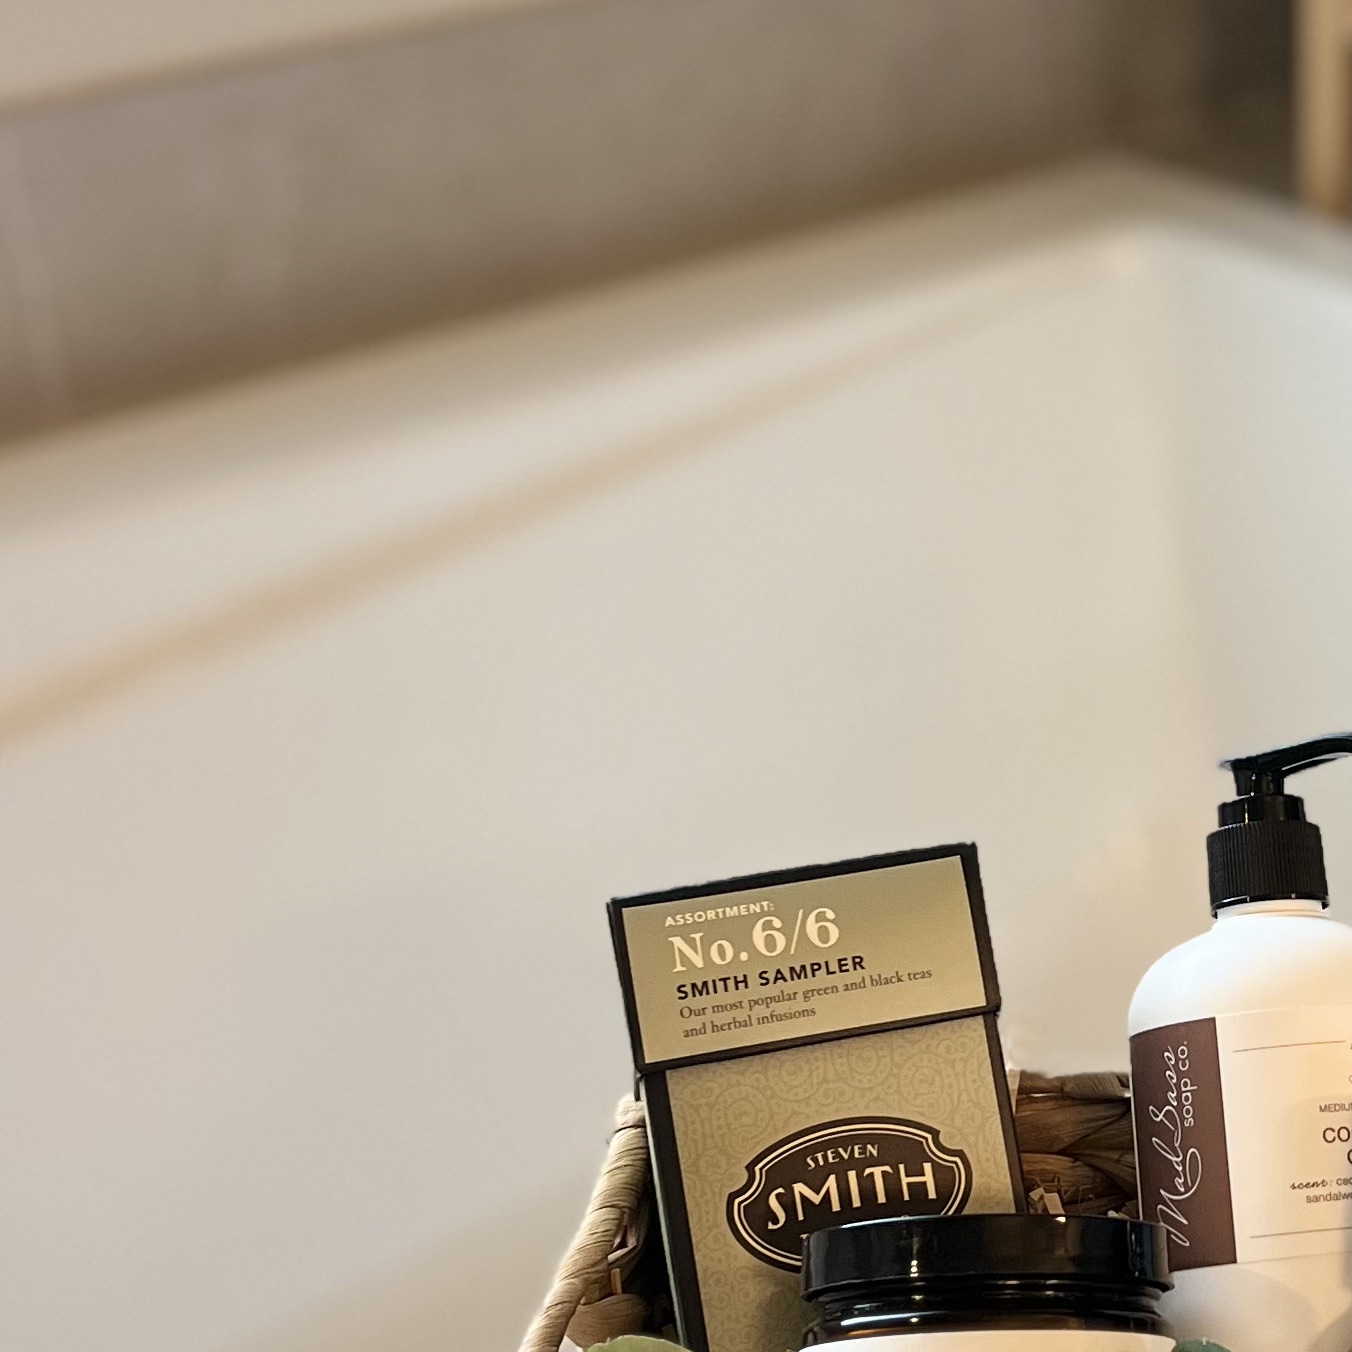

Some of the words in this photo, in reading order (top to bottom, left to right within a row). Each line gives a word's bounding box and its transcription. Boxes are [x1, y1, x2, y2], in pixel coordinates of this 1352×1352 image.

[664, 901, 775, 927] ASSORTMENT:
[676, 973, 750, 1001] SMITH
[758, 955, 866, 987] SAMPLER
[679, 1005, 708, 1019] Our
[711, 1000, 745, 1015] most
[747, 988, 799, 1012] popular
[802, 984, 839, 1003] green
[842, 975, 867, 992] and
[869, 971, 905, 989] black
[907, 967, 933, 981] teas
[683, 1021, 708, 1039] and
[710, 1012, 754, 1034] herbal
[756, 1004, 817, 1027] infusions
[1184, 1079, 1198, 1127] soap
[806, 1143, 879, 1171] STEVEN
[767, 1161, 938, 1231] SMITH
